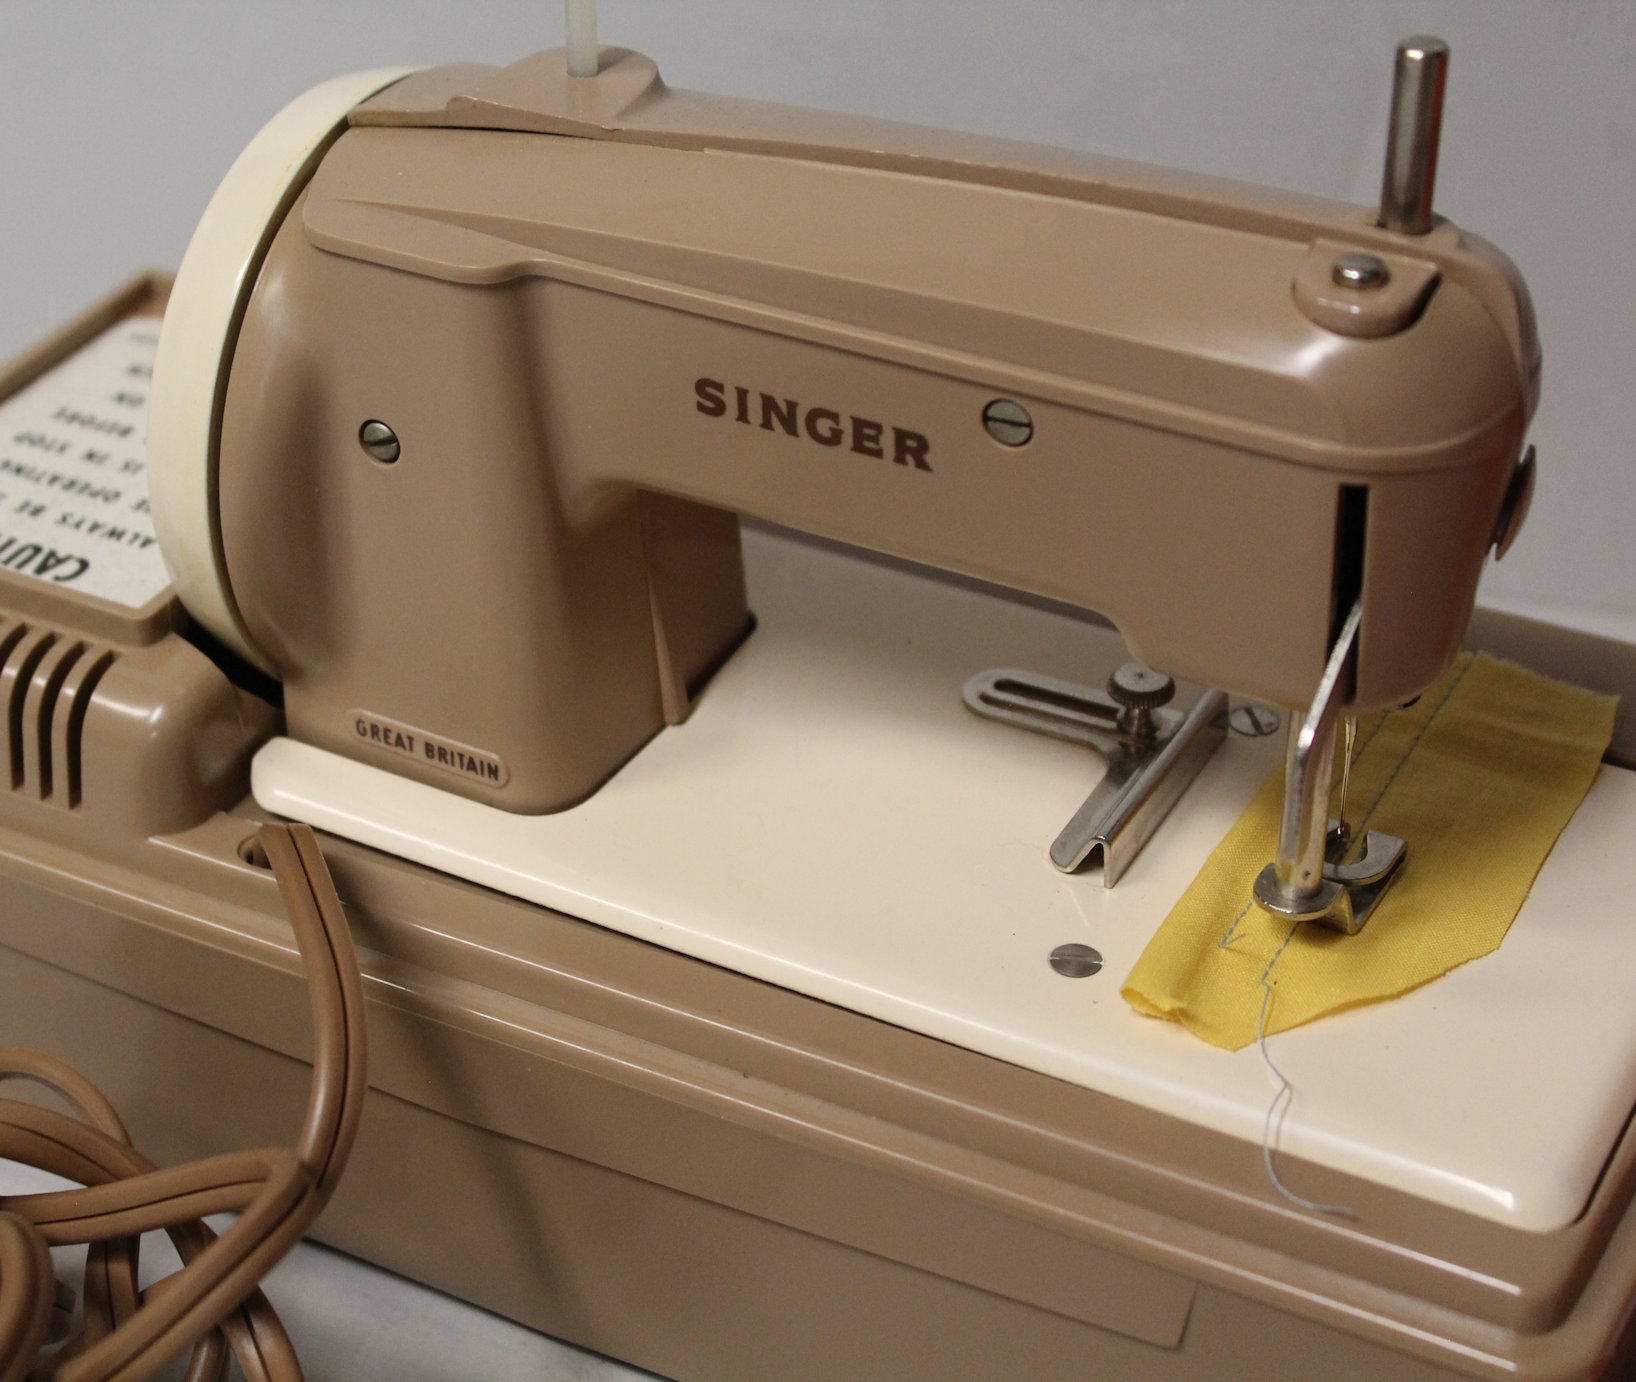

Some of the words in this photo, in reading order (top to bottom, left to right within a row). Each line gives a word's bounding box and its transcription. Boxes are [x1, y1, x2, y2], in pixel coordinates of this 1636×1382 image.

[694, 377, 933, 472] SINGER
[14, 500, 46, 518] BE
[55, 512, 157, 549] ALWAYS
[355, 718, 414, 752] GREAT
[424, 741, 499, 781] BRITAIN
